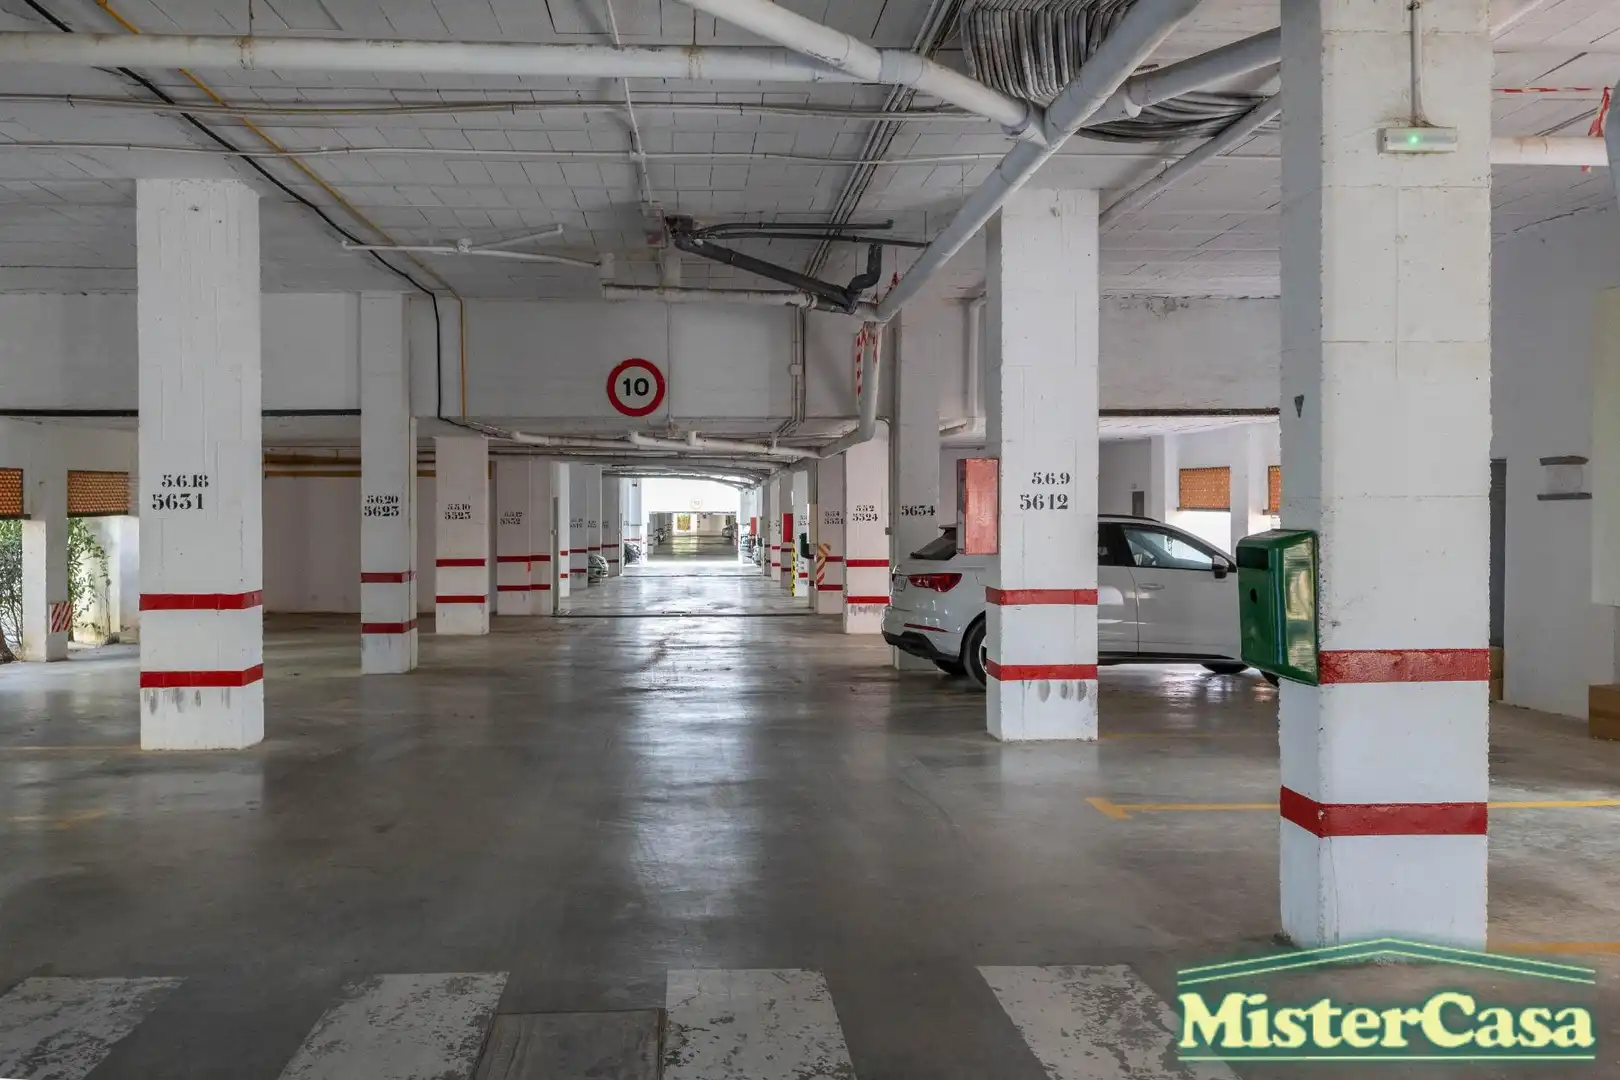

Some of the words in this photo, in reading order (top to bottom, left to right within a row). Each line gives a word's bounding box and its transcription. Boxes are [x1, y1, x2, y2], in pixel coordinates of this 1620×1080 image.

[622, 377, 650, 397] 10
[161, 474, 209, 488] 5.6.18
[1031, 471, 1071, 485] 5.6.9
[152, 493, 204, 510] 5631
[1019, 493, 1068, 510] 5612
[364, 505, 400, 517] 5623
[901, 505, 936, 516] 5634
